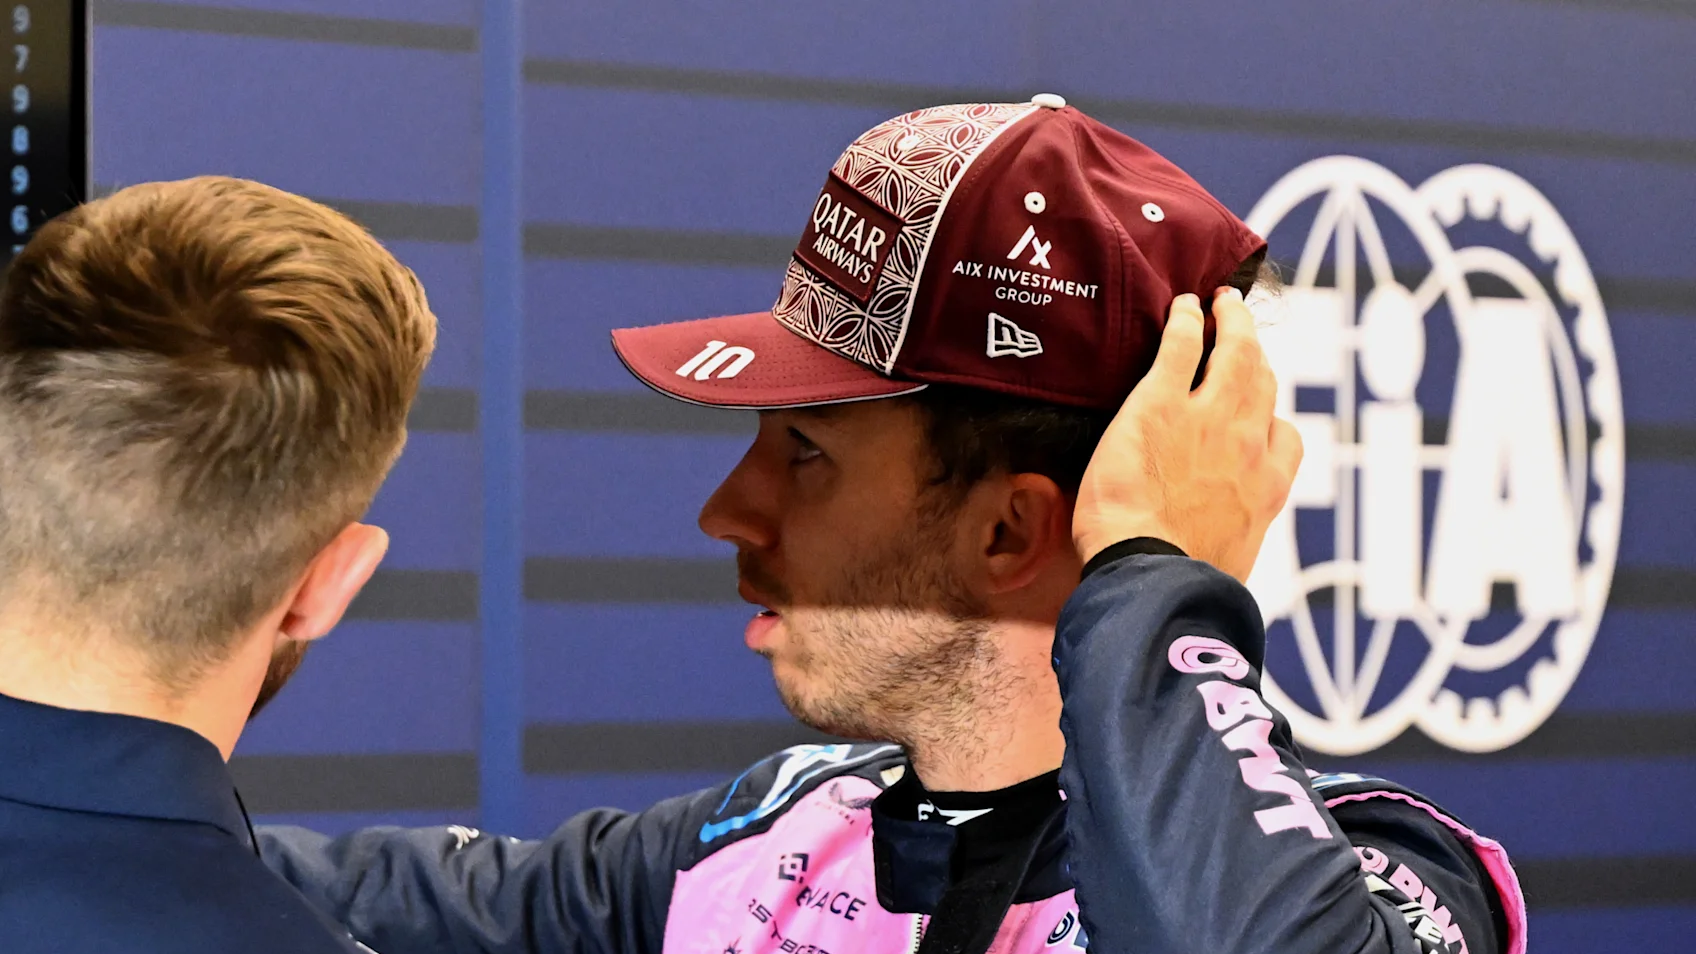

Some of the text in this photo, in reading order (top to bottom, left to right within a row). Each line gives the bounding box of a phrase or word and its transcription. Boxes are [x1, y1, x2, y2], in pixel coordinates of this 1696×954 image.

[13, 44, 30, 72] 7
[813, 193, 886, 263] QATAR
[812, 233, 874, 284] AIRWAYS
[952, 260, 1098, 299] AIX INVESTMENT
[995, 286, 1052, 306] GROUP
[675, 340, 755, 381] 10
